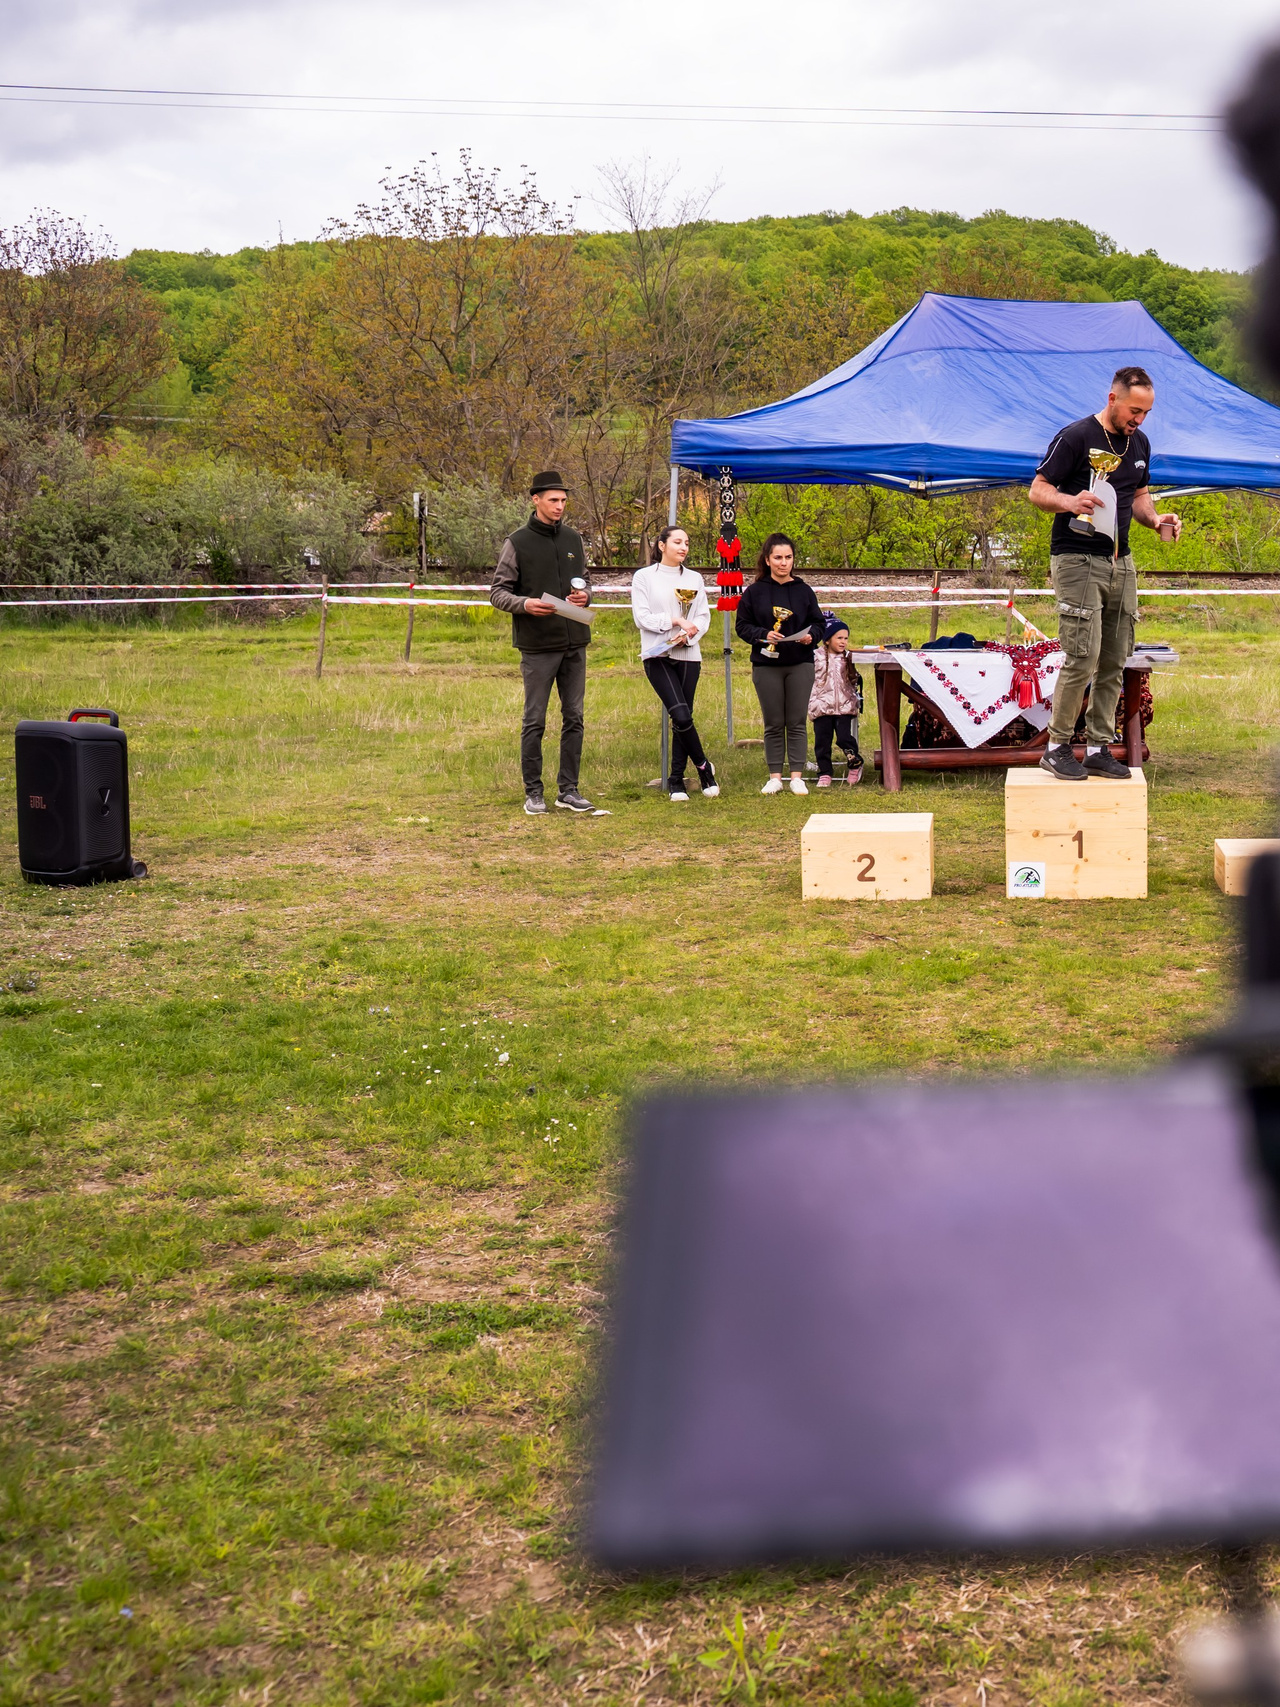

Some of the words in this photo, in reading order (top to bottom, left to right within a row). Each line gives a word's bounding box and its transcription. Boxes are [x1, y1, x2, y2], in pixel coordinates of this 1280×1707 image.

[29, 795, 46, 809] JBL
[1072, 830, 1084, 859] 1
[857, 853, 876, 882] 2
